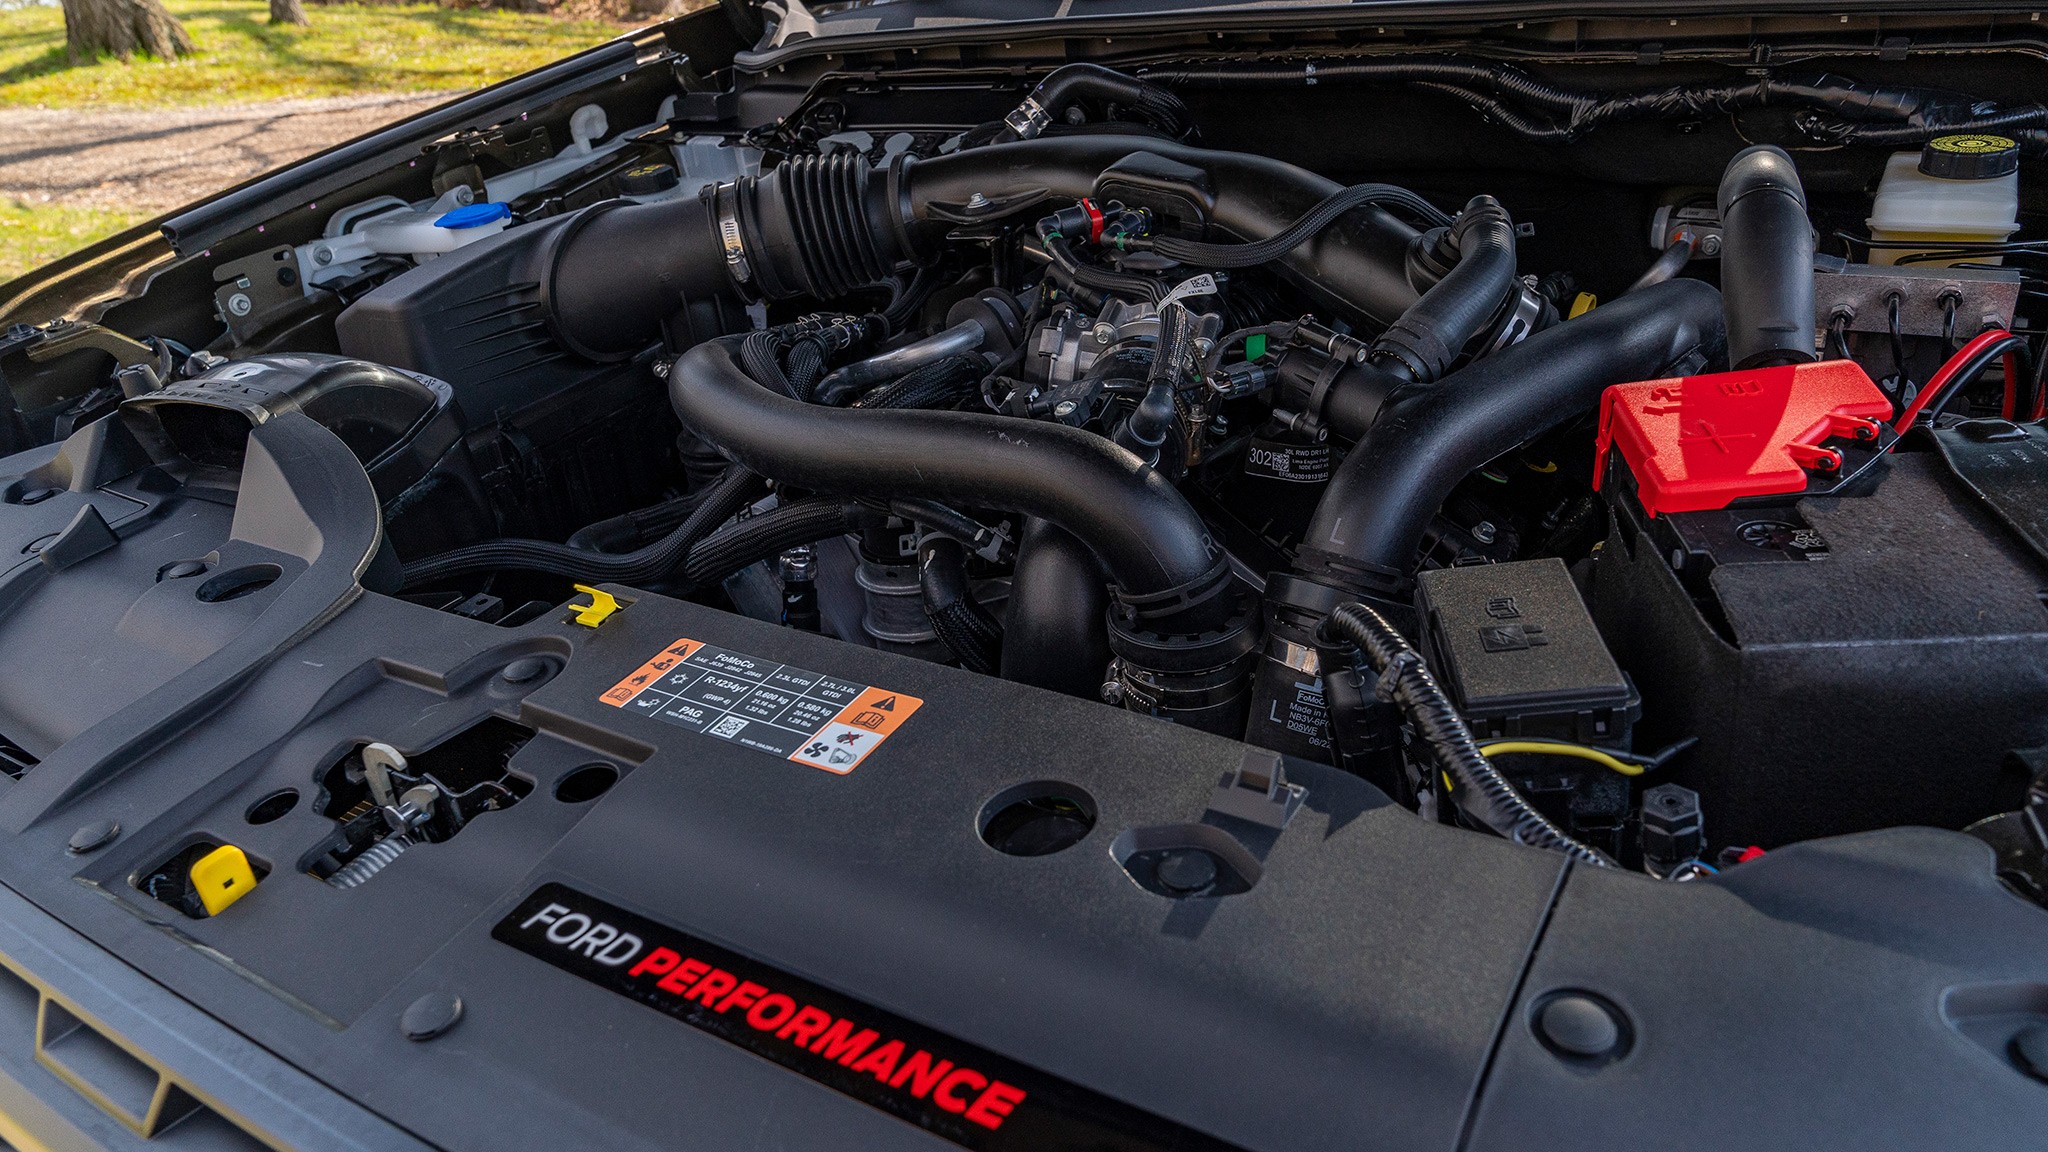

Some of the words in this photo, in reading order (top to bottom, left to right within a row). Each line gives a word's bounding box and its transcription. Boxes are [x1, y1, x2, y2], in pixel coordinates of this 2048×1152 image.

[1250, 448, 1272, 466] 302
[1330, 518, 1344, 545] L
[1202, 533, 1218, 560] R
[694, 656, 709, 664] SAE
[715, 653, 755, 668] FoMoCo
[704, 676, 750, 693] R-1234yf
[776, 673, 791, 682] 2.3L
[792, 677, 811, 686] GTDI
[820, 680, 836, 690] 2.7L
[840, 686, 856, 694] 3.0L
[755, 690, 778, 700] 0.600
[777, 696, 789, 704] kg
[822, 690, 842, 699] GTDI
[1300, 693, 1325, 706] FoMoC
[678, 706, 704, 718] PAG
[797, 702, 822, 712] 0.580
[820, 707, 833, 717] kg
[1270, 700, 1282, 723] L
[1290, 702, 1312, 714] Made
[1314, 709, 1321, 717] in
[1288, 720, 1318, 734] D05WE
[520, 902, 643, 966] FORD
[628, 946, 1027, 1130] PERFORMANCE
